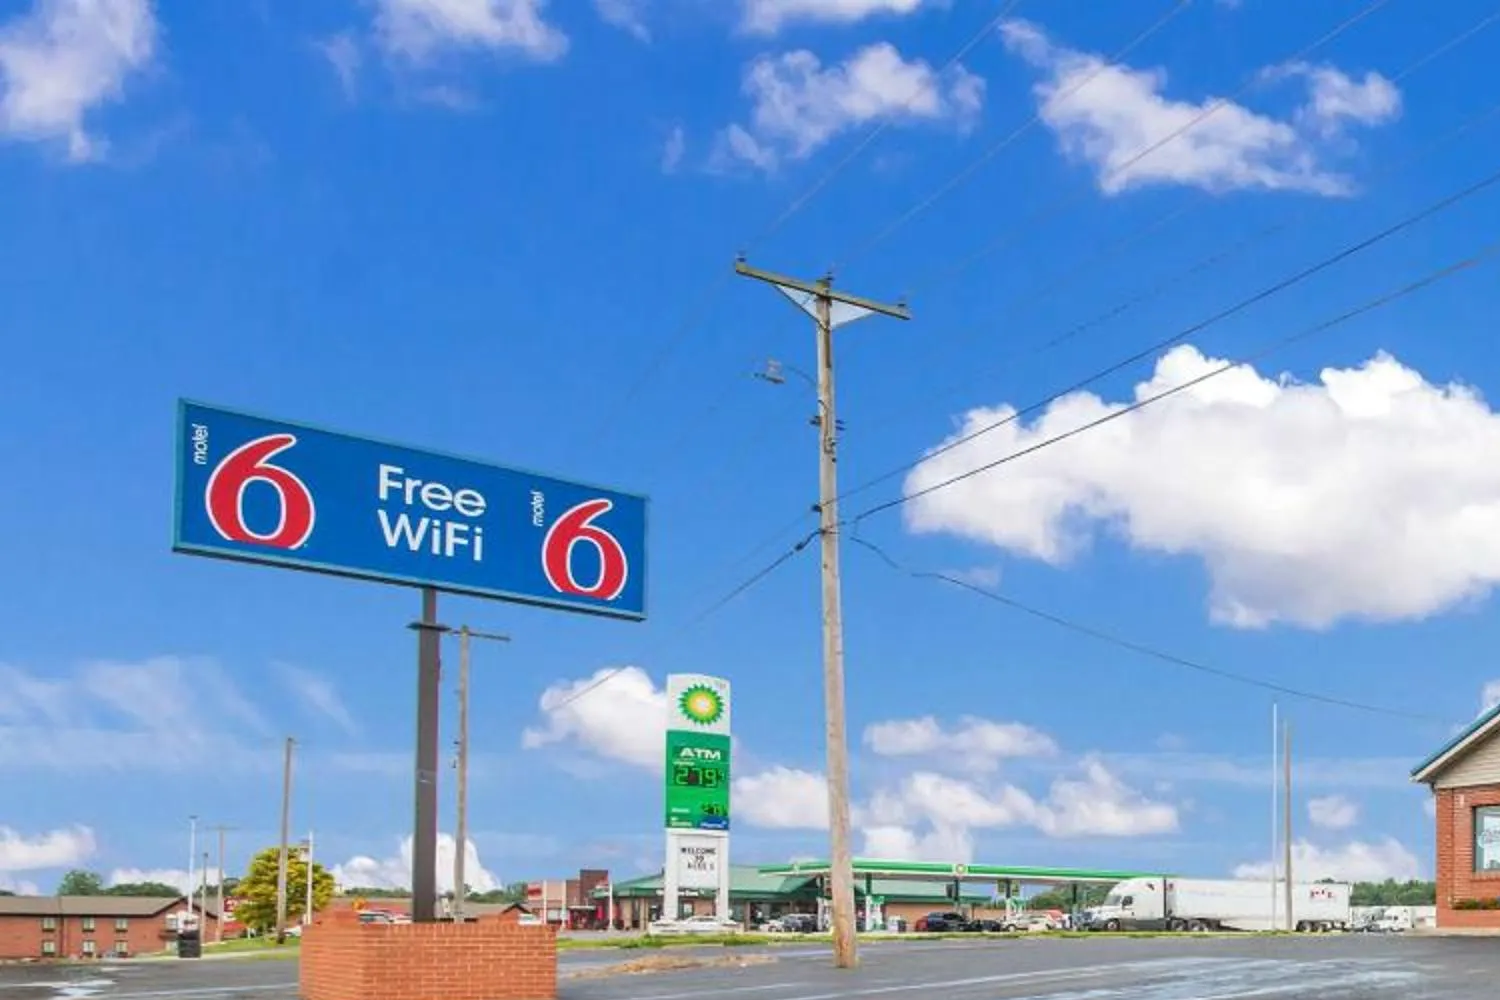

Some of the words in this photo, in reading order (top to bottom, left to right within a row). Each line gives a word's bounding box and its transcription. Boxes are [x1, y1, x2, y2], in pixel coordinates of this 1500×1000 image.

[192, 424, 209, 465] motel
[205, 433, 315, 550] 6
[379, 465, 487, 518] Free
[377, 510, 482, 561] WiFi
[530, 490, 545, 527] motel
[542, 498, 628, 601] 6
[680, 747, 721, 760] ATM
